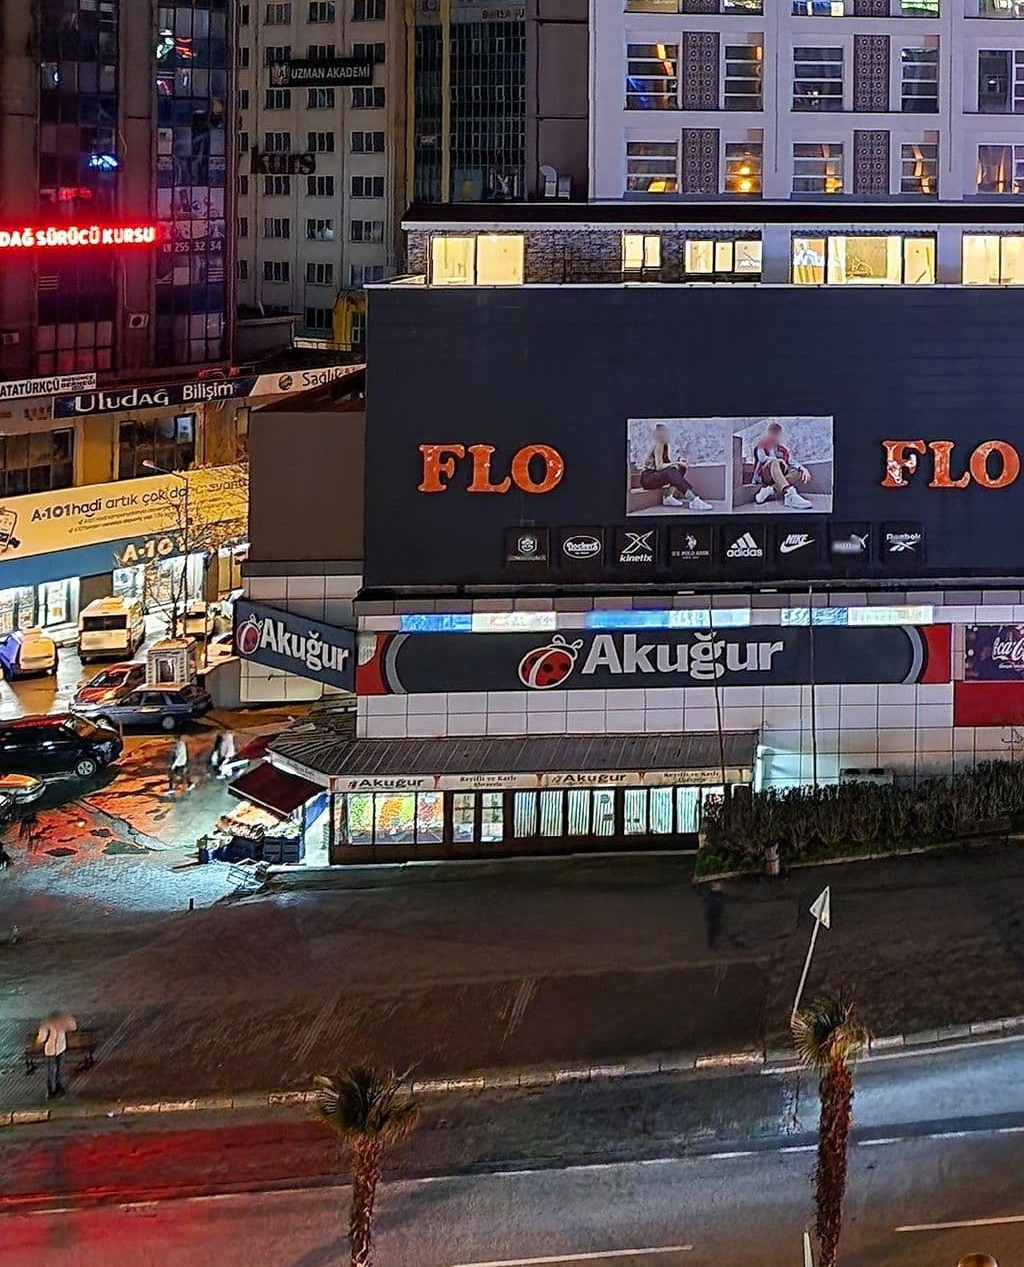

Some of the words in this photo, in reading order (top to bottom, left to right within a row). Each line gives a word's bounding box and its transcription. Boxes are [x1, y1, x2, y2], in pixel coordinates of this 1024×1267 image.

[291, 68, 324, 79] UZMAN
[327, 64, 370, 78] AKADEMİ
[0, 227, 35, 247] DAĞ
[36, 225, 99, 246] SÜRÜCÜ
[102, 227, 155, 244] KURSU
[174, 242, 189, 252] 255
[194, 241, 205, 251] 32
[210, 240, 221, 251] 34
[182, 382, 234, 401] Bilişim
[417, 444, 565, 494] FLO
[881, 439, 1021, 489] FLO
[786, 534, 808, 544] NIKE
[619, 554, 653, 563] kinetix
[726, 548, 763, 558] adidas
[260, 629, 349, 673] Akuğur
[581, 631, 784, 680] Akuğur
